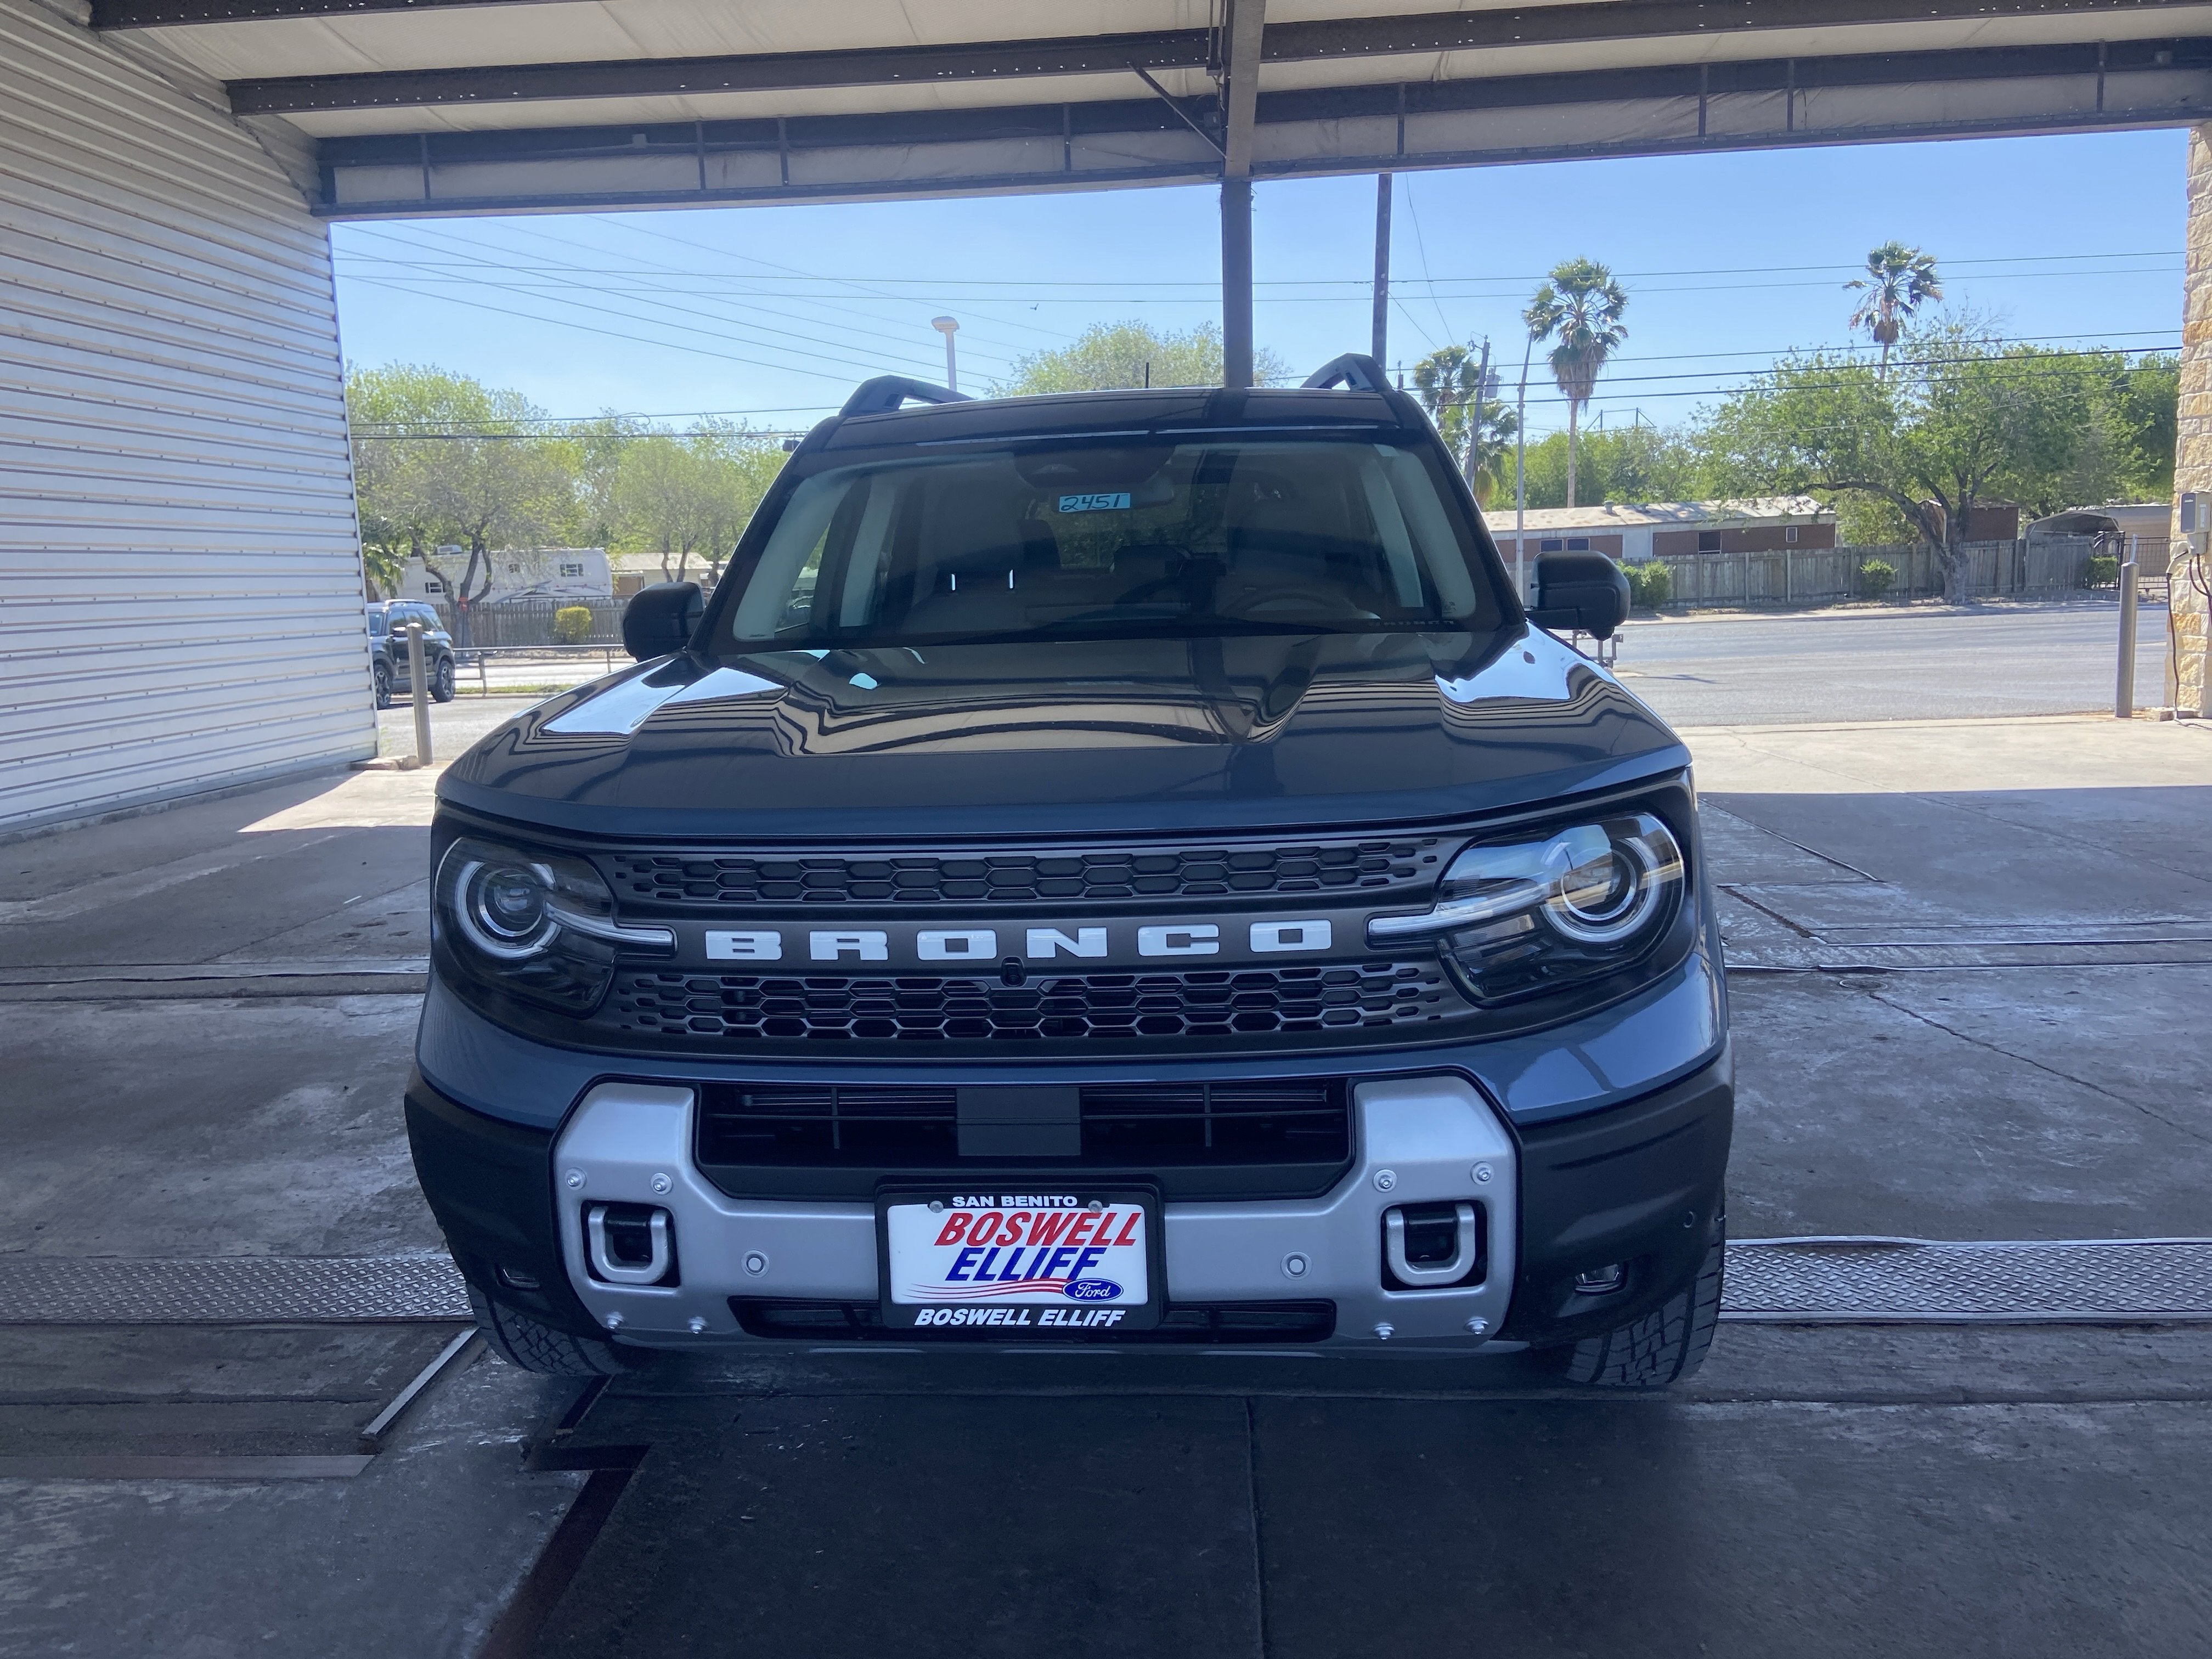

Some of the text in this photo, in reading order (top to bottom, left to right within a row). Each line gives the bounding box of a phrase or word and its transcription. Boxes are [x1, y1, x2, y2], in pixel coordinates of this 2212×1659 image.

[1060, 494, 1120, 511] 2451
[705, 919, 1333, 961] BRONCO
[952, 1195, 1078, 1207] SAN BENITO
[934, 1212, 1142, 1246] BOSWELL
[945, 1247, 1108, 1282] ELLIFF
[1074, 1282, 1111, 1299] Ford
[914, 1308, 1126, 1327] BOSWELL ELLIFF
